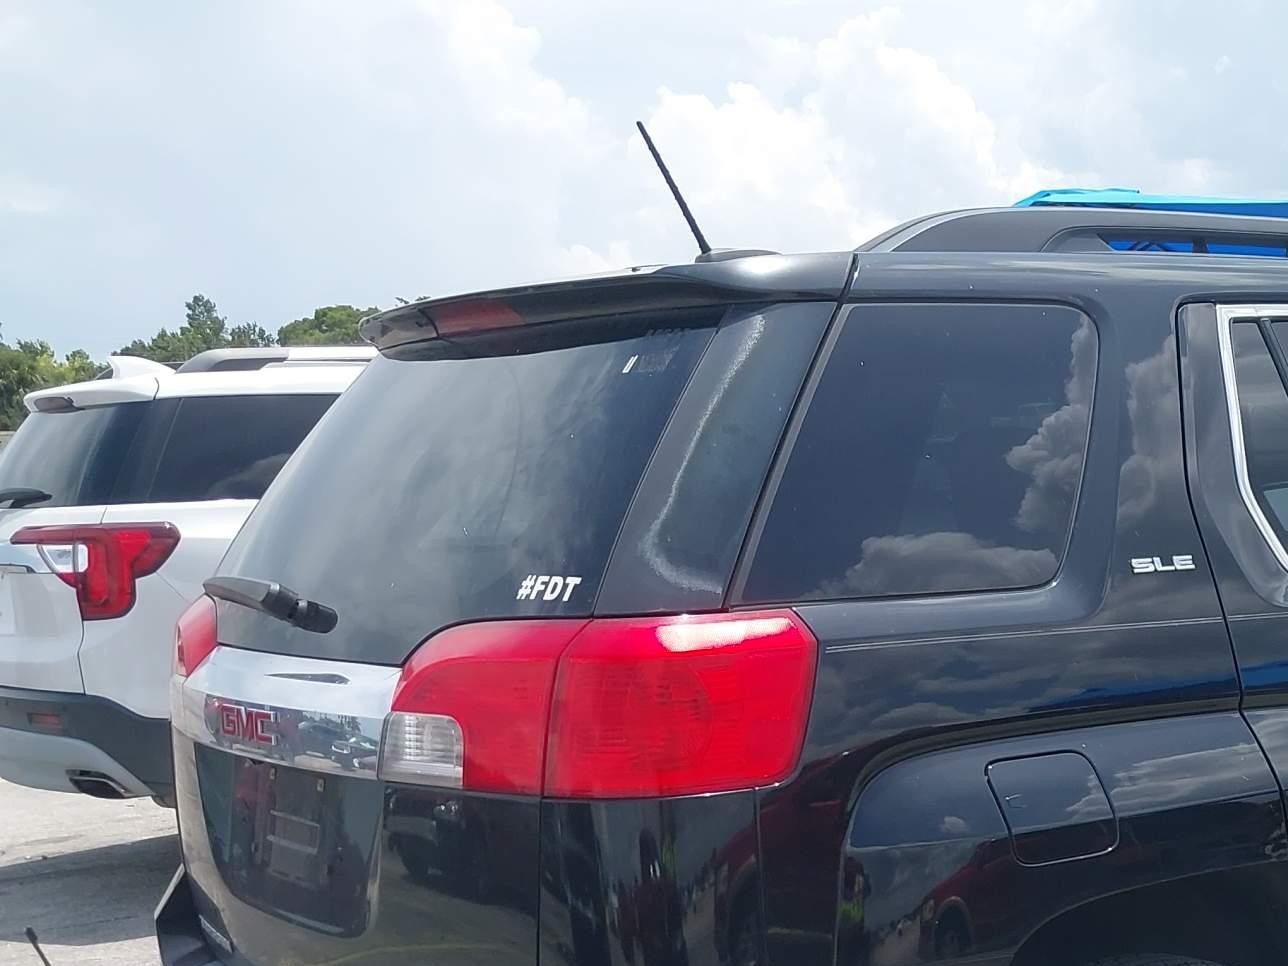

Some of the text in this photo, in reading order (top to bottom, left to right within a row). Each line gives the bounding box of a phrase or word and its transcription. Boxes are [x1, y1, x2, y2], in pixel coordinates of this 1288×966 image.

[1131, 554, 1196, 574] SLE
[516, 574, 582, 602] #FDT
[220, 703, 279, 746] GMC
